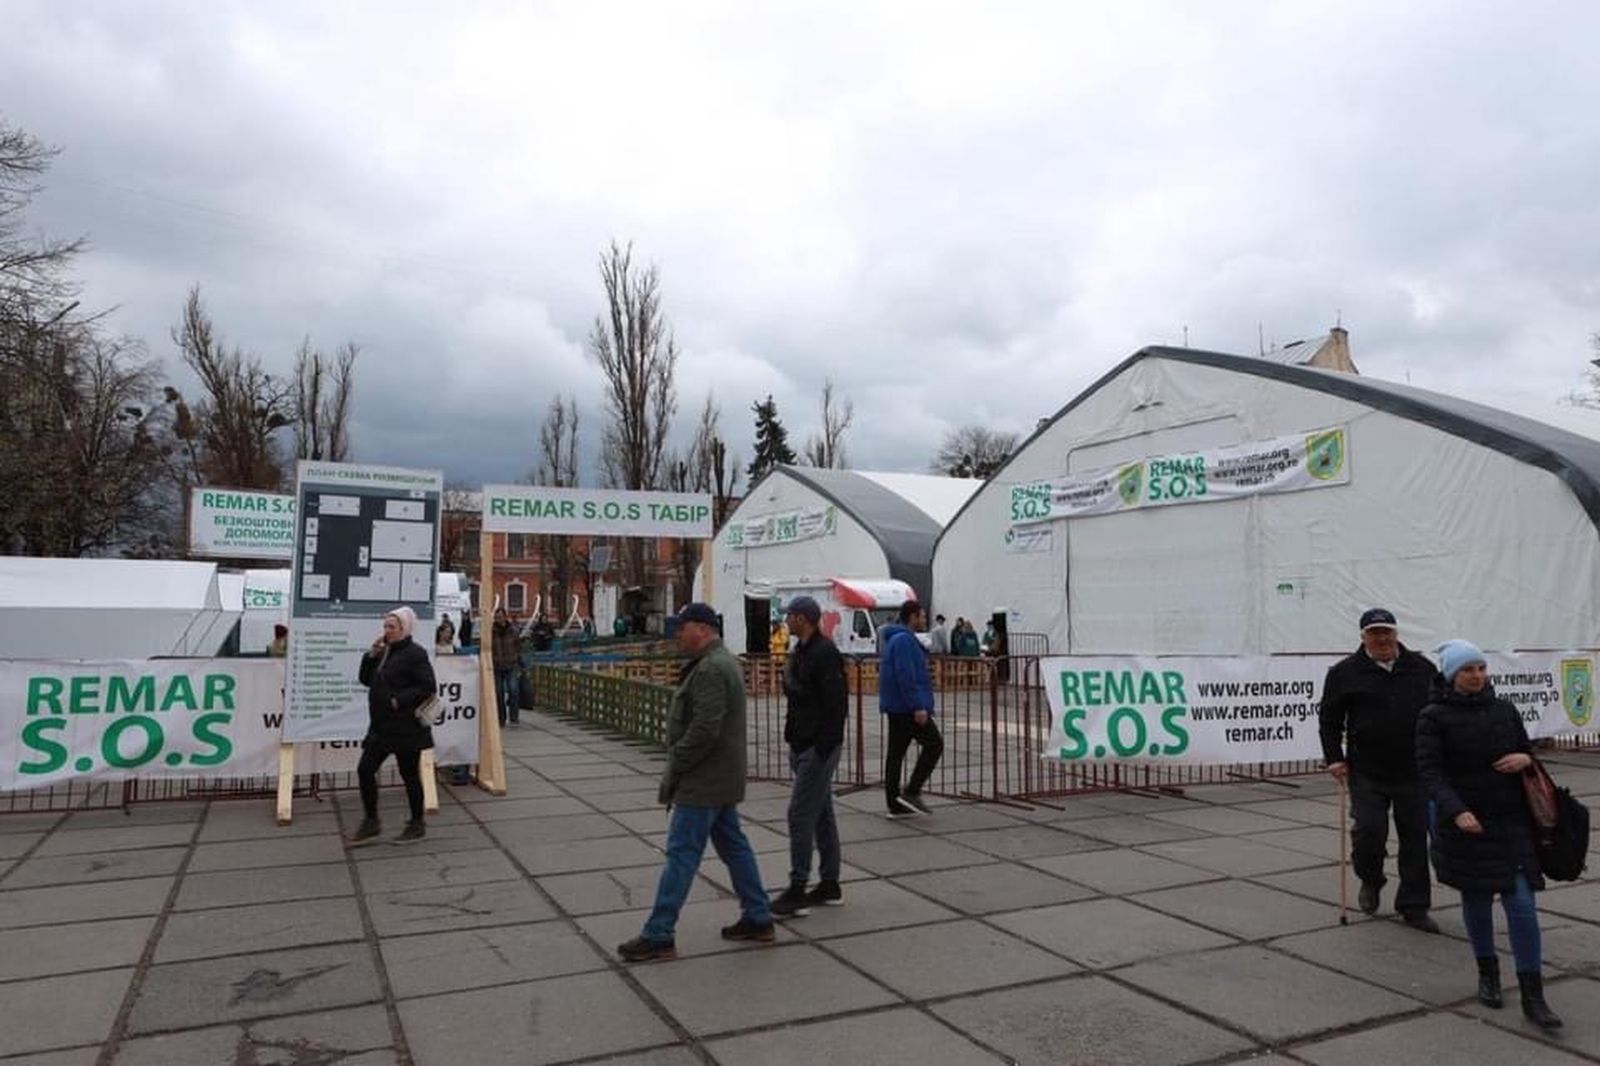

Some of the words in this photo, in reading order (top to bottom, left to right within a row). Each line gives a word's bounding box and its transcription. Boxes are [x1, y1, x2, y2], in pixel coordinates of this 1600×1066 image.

[1150, 457, 1205, 478] REMAR
[1149, 474, 1207, 500] S.O.S
[202, 492, 268, 511] REMAR
[491, 497, 575, 518] REMAR
[583, 501, 641, 521] S.O.S
[648, 503, 709, 523] ТАБІР
[1012, 498, 1051, 521] S.O.S
[26, 674, 236, 715] REMAR
[1060, 670, 1187, 706] REMAR
[1198, 681, 1314, 700] www.remar.org
[18, 713, 234, 775] S.O.S
[1060, 706, 1190, 759] S.O.S
[1225, 722, 1294, 743] remar.ch
